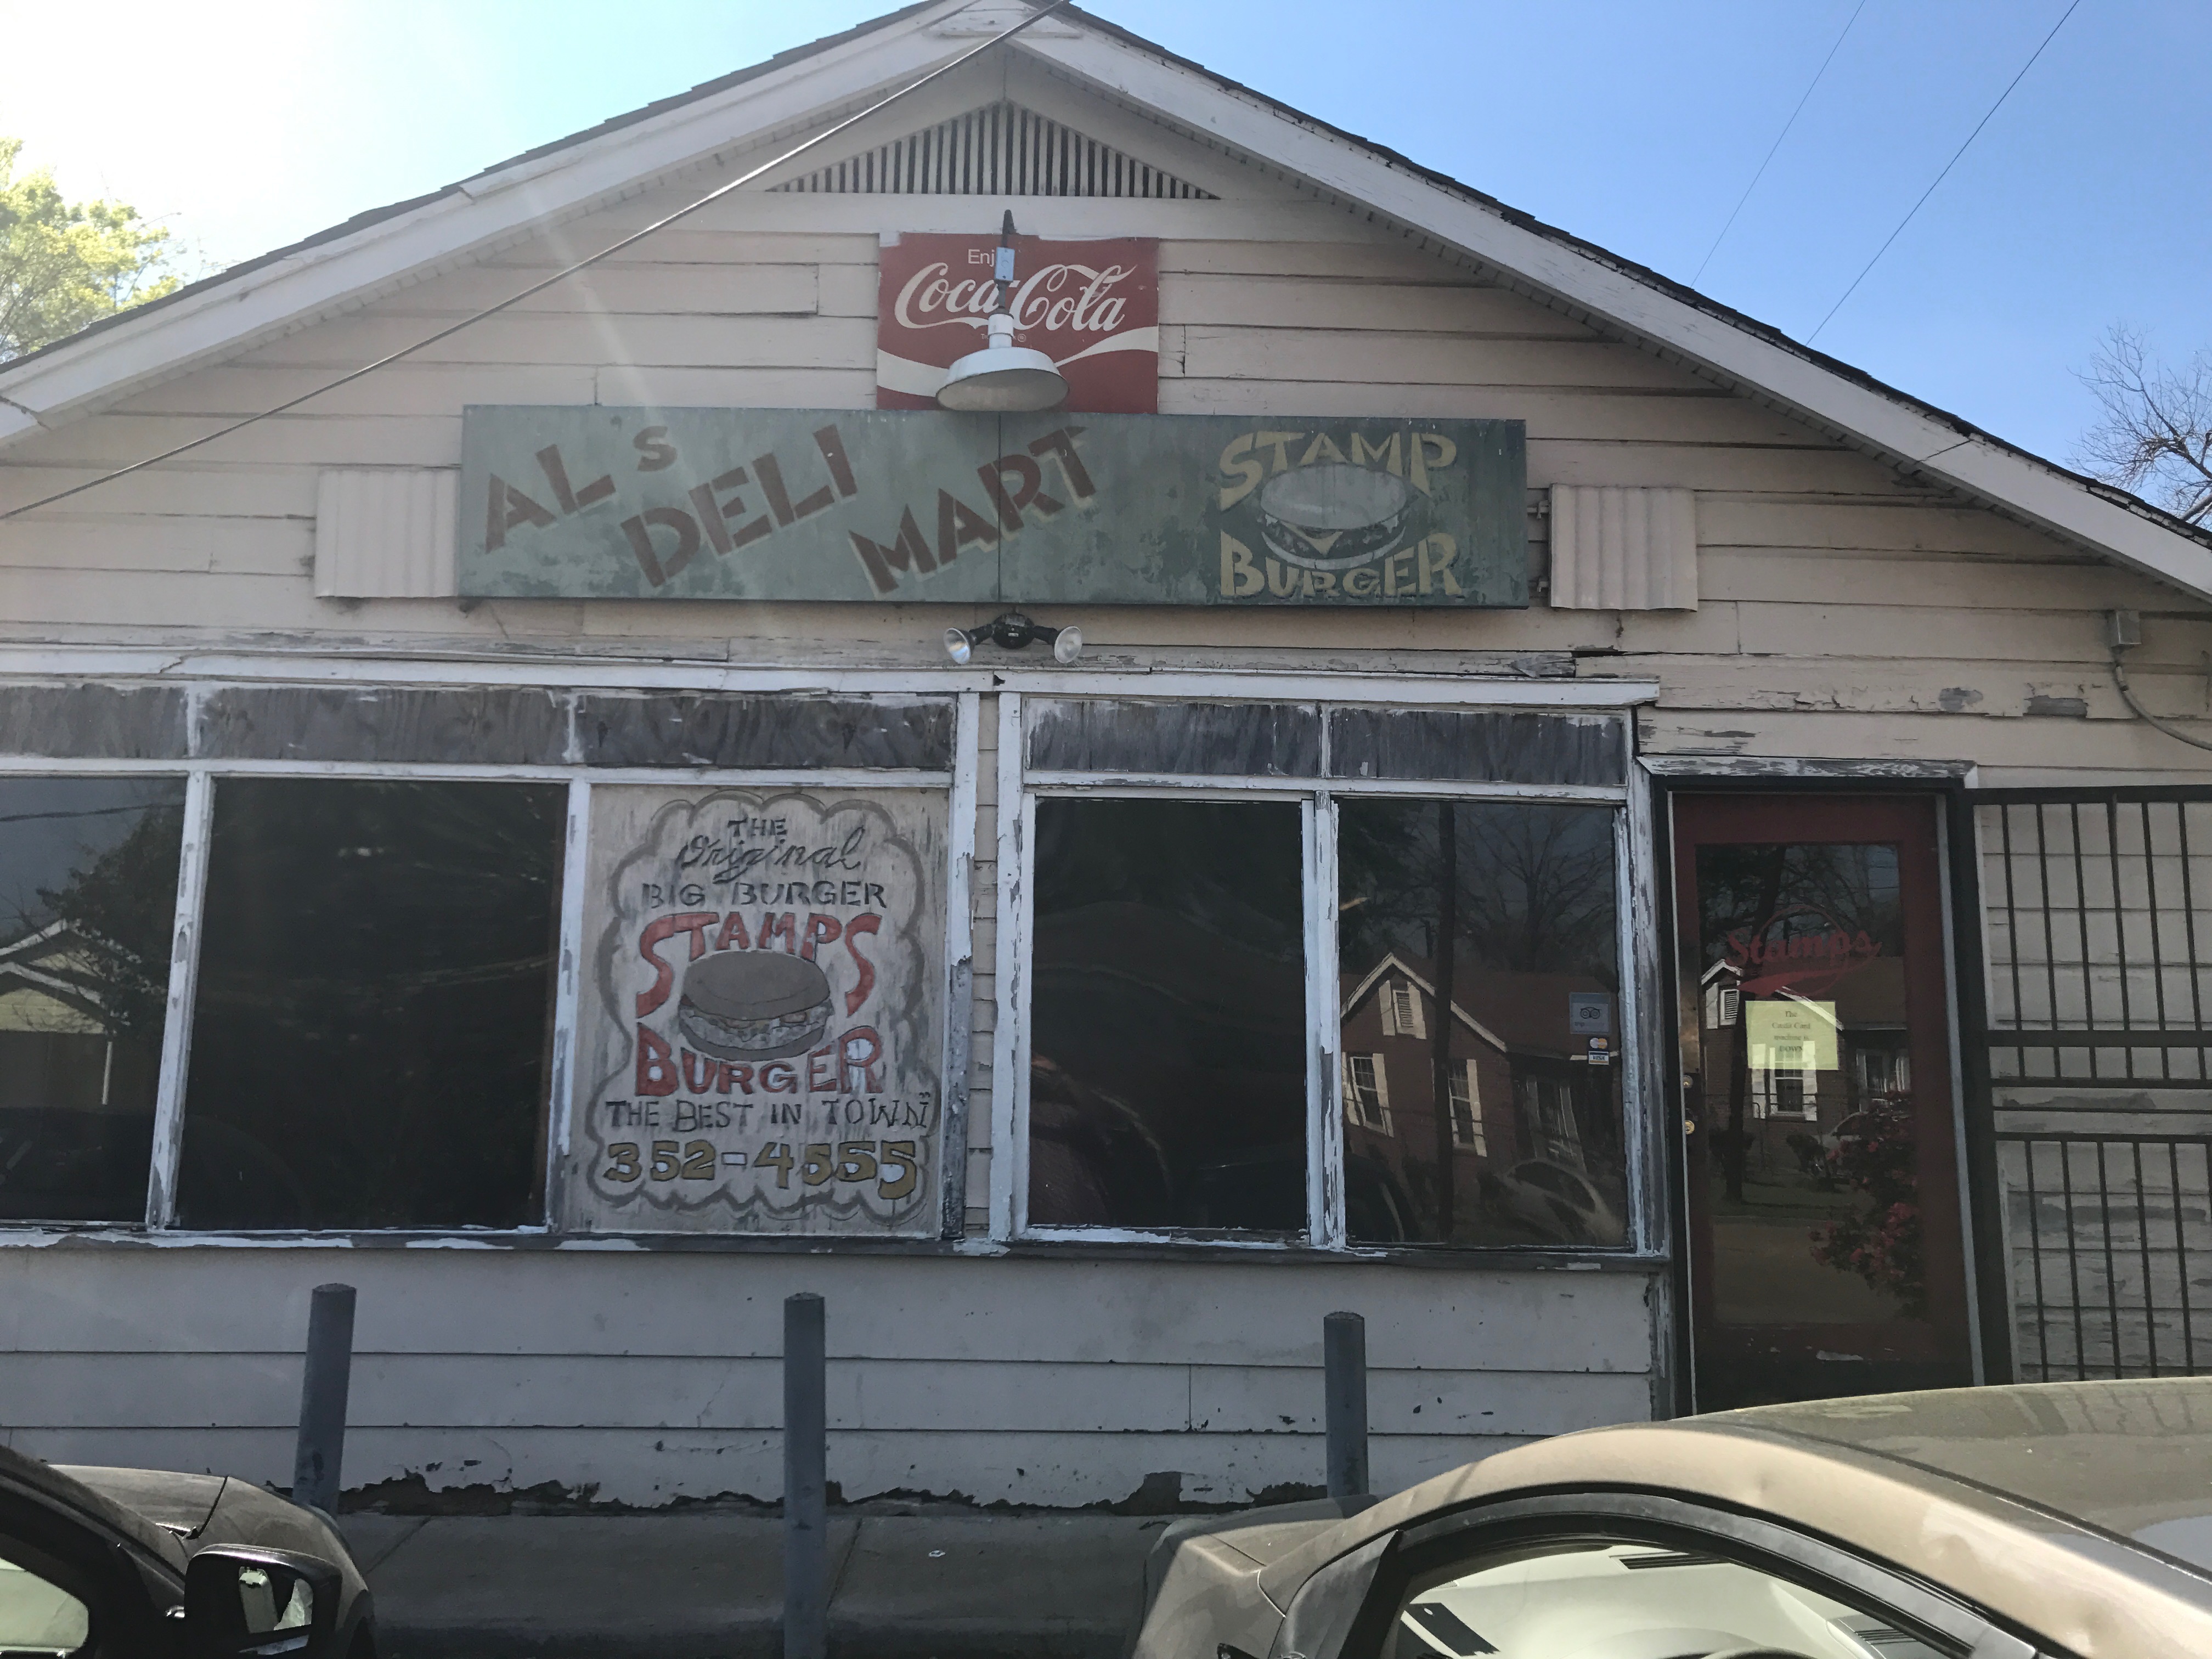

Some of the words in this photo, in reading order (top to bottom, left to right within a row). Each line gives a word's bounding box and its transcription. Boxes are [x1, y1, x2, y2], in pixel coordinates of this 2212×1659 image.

[967, 249, 996, 267] Enj
[894, 262, 1137, 331] Coca-Cola
[620, 424, 859, 588] DELI
[1219, 431, 1457, 512] STAMP
[848, 425, 1096, 595] MART
[1220, 529, 1463, 598] BURGER
[676, 826, 866, 884] Original
[728, 817, 787, 837] THE
[641, 882, 706, 909] BIG
[731, 880, 888, 909] BURGER
[635, 911, 883, 1019] STAMPS
[635, 1022, 884, 1097] BURGER
[605, 1099, 659, 1127] THE
[672, 1099, 754, 1132] BEST
[770, 1103, 802, 1125] IN
[602, 1139, 918, 1200] 352-4555
